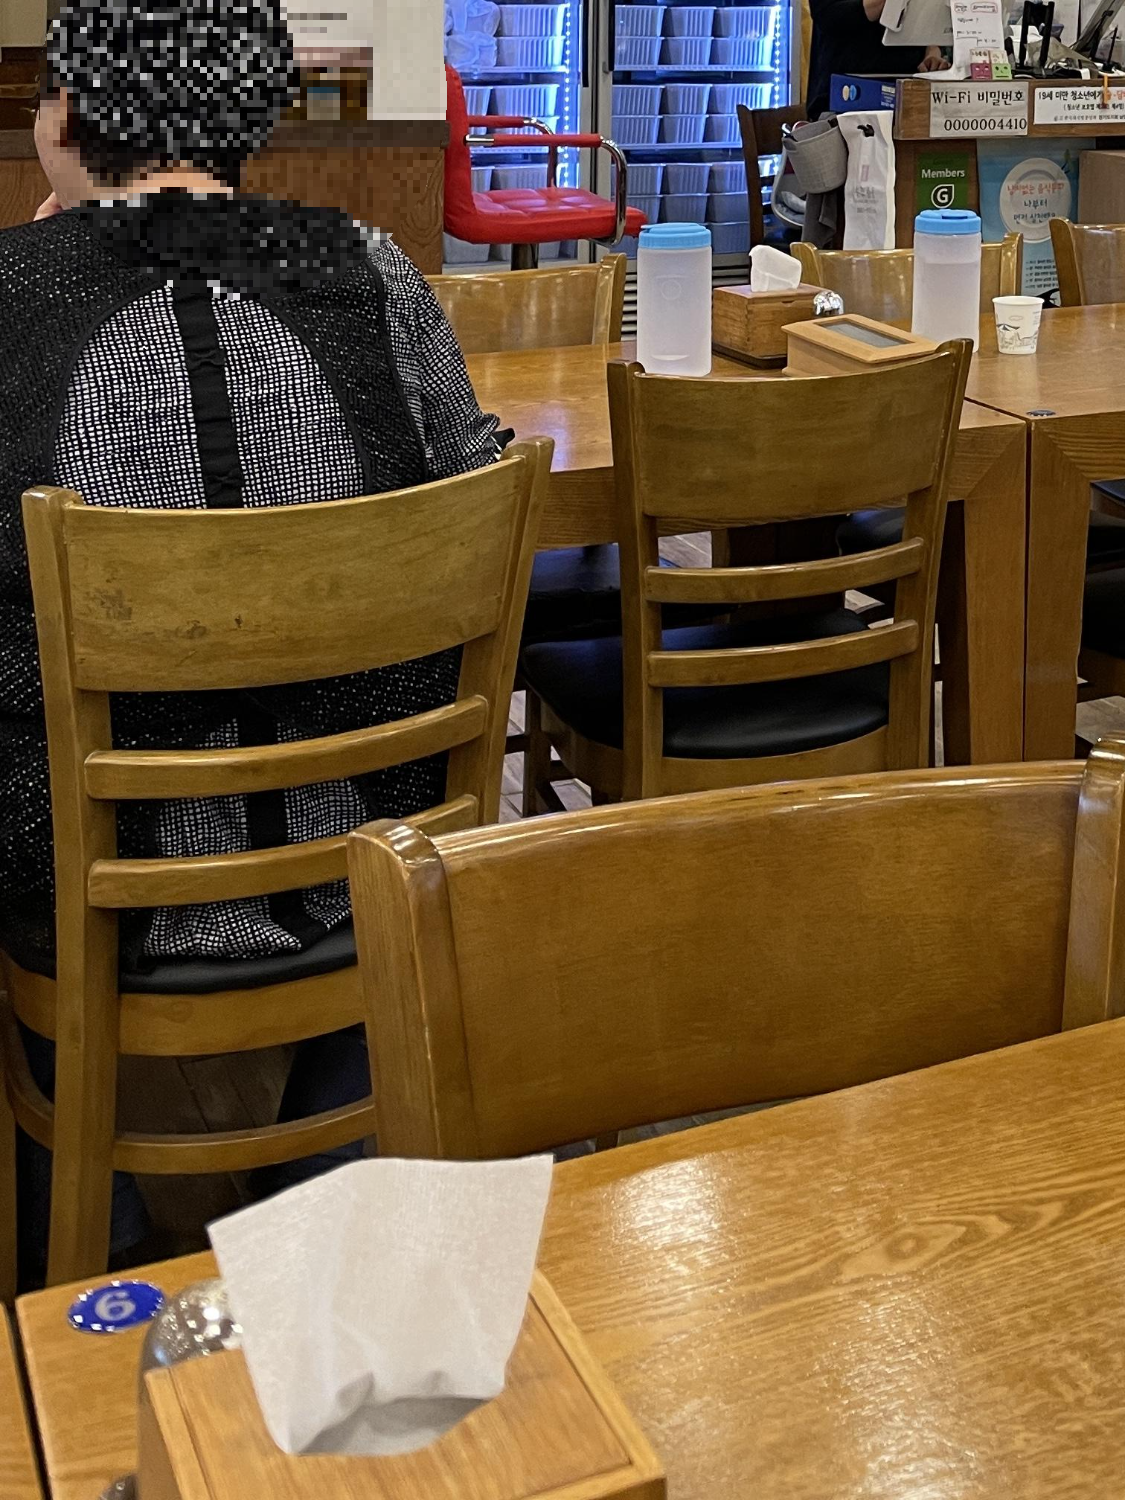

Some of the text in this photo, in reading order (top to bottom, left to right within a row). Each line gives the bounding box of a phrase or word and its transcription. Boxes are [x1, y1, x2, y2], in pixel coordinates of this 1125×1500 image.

[931, 90, 1025, 106] Wi-Fi 비밀번호
[1055, 90, 1069, 101] 미만
[944, 118, 1027, 131] 0000004410
[921, 168, 965, 179] Members
[94, 1289, 136, 1322] 6
